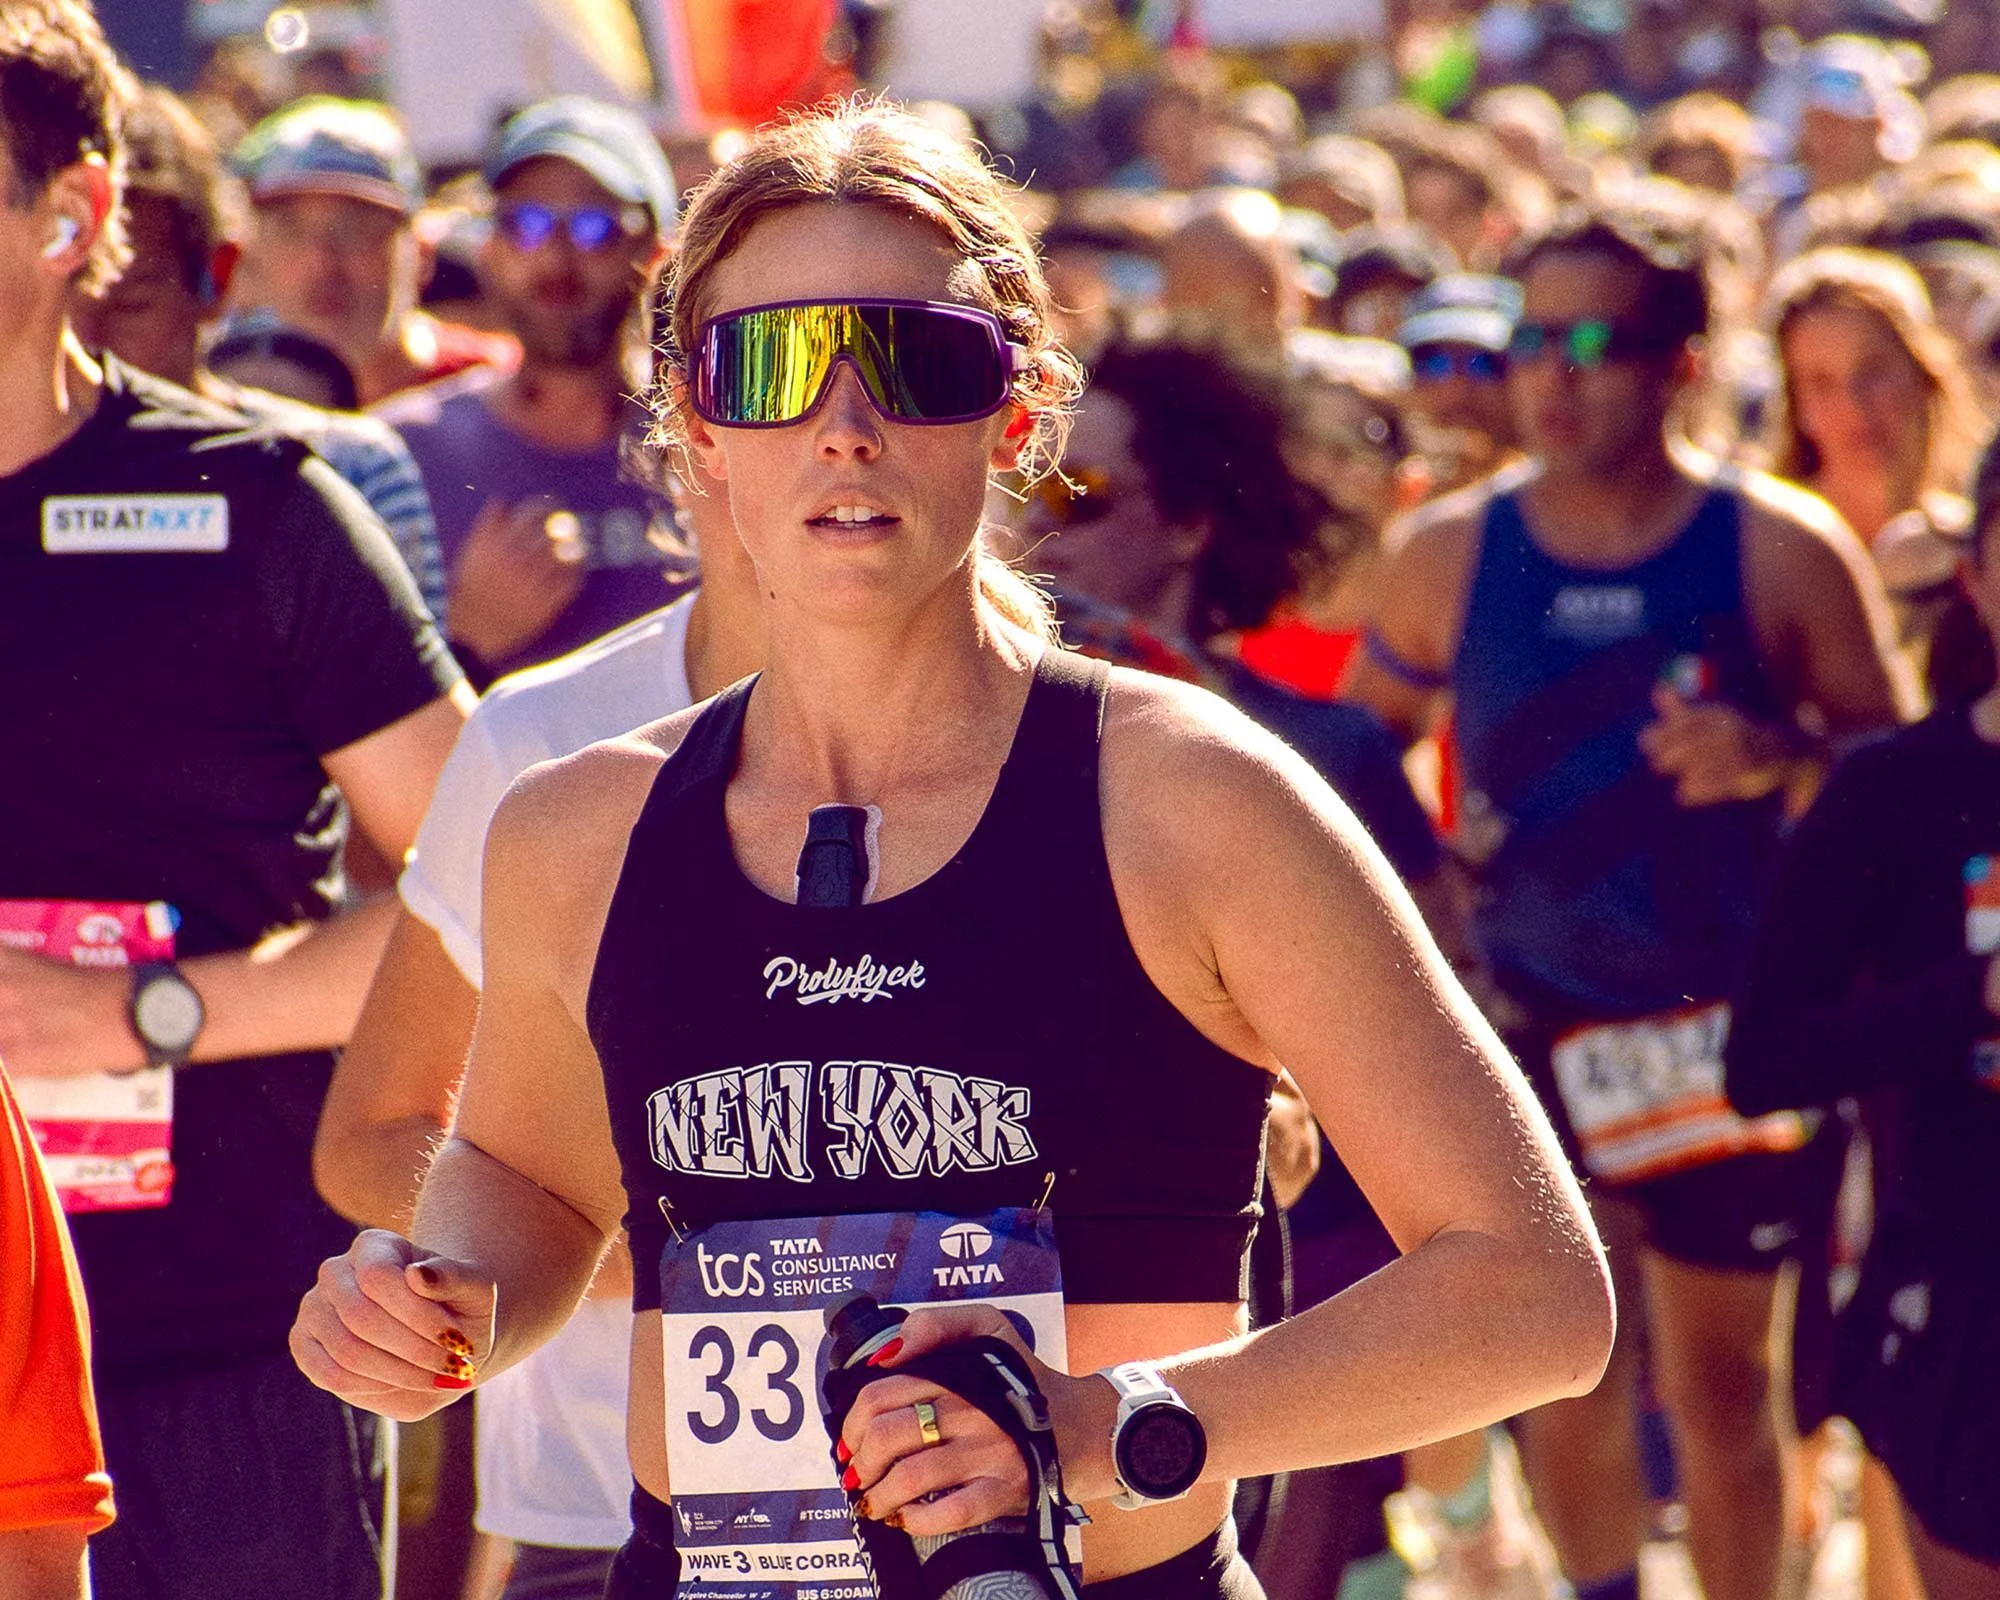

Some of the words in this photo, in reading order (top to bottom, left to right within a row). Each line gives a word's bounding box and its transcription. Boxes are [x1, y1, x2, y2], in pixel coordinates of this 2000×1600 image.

[55, 507, 213, 532] STRATNXT
[763, 953, 926, 1005] Prolyfyck
[646, 1060, 815, 1183] NEW
[820, 1060, 1039, 1180] YORK
[769, 1238, 823, 1256] TATA
[697, 1242, 765, 1297] tcs
[771, 1253, 897, 1276] CONSULTANCY
[933, 1263, 1005, 1287] TATA
[773, 1276, 853, 1297] SERVICES
[686, 1323, 829, 1445] 33
[687, 1554, 732, 1570] WAVE
[733, 1550, 752, 1574] 3
[758, 1555, 793, 1571] BLUE
[797, 1588, 819, 1600] BUS
[820, 1586, 874, 1600] 6:00AM
